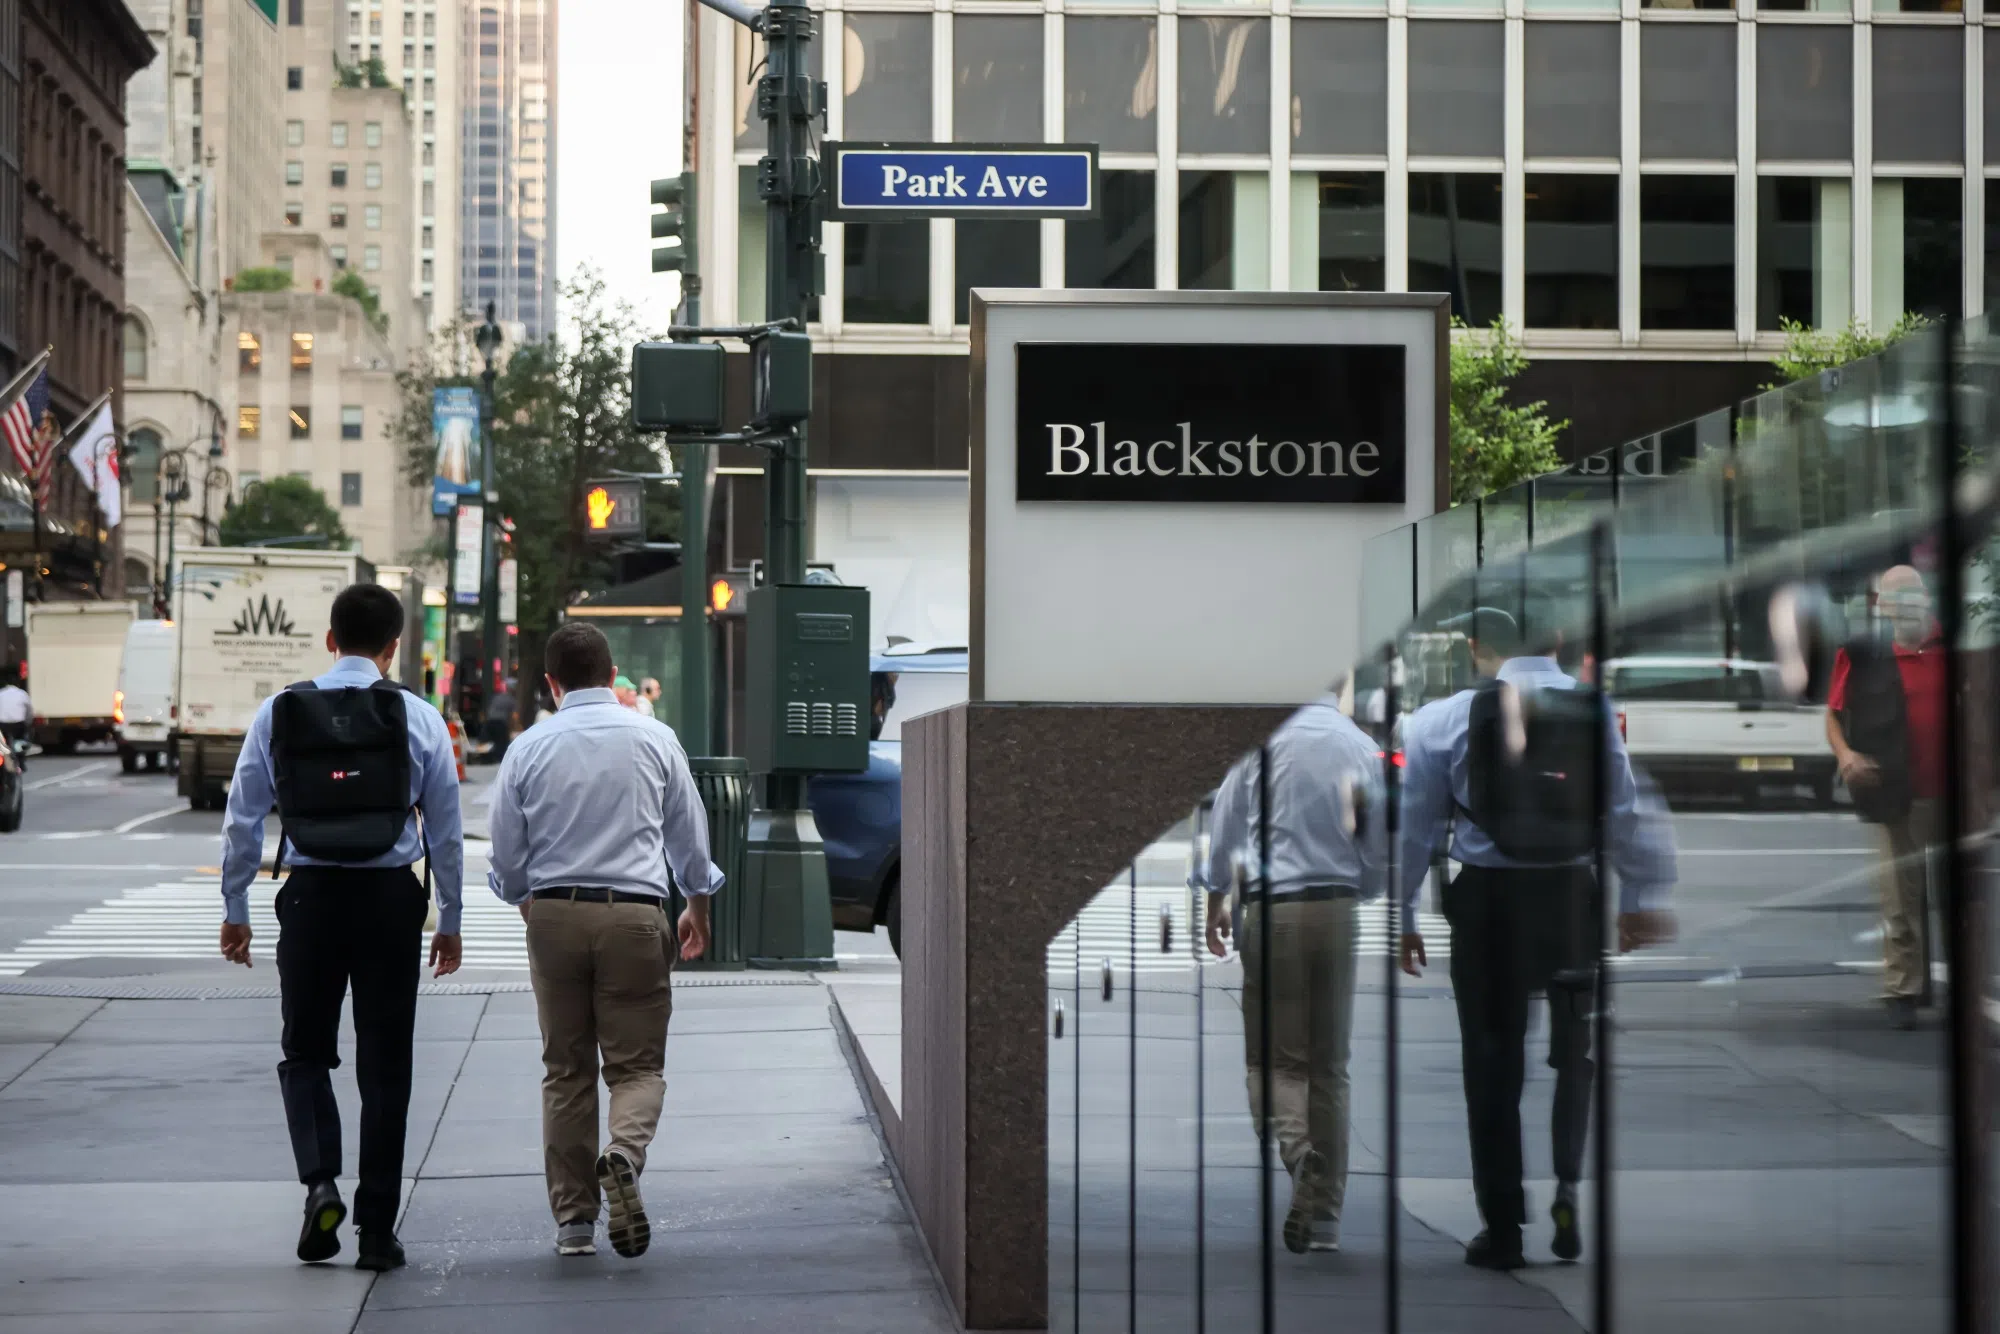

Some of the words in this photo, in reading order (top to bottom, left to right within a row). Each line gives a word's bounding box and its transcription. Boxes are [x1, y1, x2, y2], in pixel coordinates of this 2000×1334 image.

[881, 165, 967, 197] Park
[976, 166, 1048, 197] Ave
[1045, 420, 1381, 477] Blackstone
